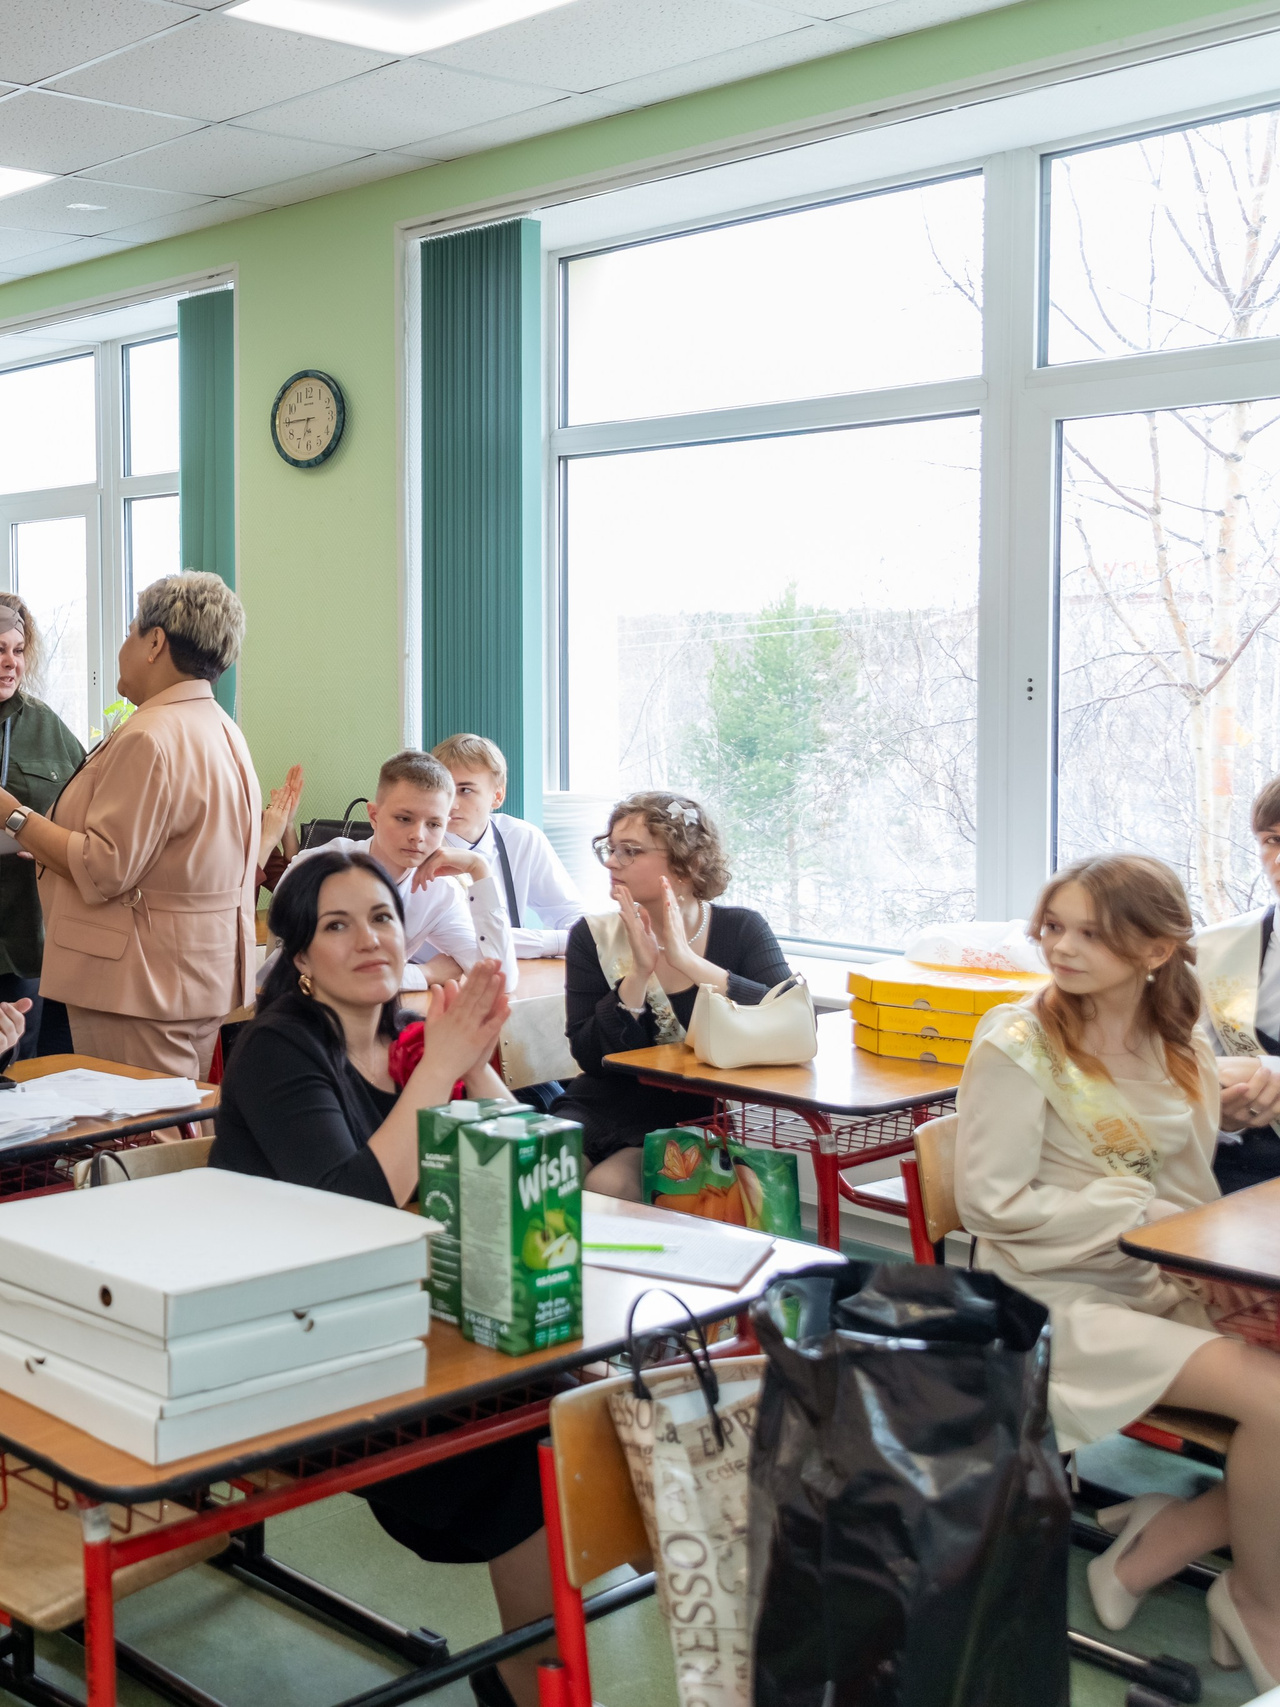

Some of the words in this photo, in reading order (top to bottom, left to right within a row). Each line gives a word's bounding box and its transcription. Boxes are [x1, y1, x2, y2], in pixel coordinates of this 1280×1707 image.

[296, 392, 302, 403] 11
[305, 387, 313, 399] 12
[318, 389, 321, 400] 1
[325, 397, 330, 409] 2
[288, 404, 296, 415] 10
[328, 410, 333, 421] 3
[289, 429, 294, 440] 8
[324, 425, 329, 435] 4
[297, 438, 301, 449] 7
[306, 440, 311, 451] 6
[316, 436, 322, 446] 5
[697, 1406, 756, 1458] EPR
